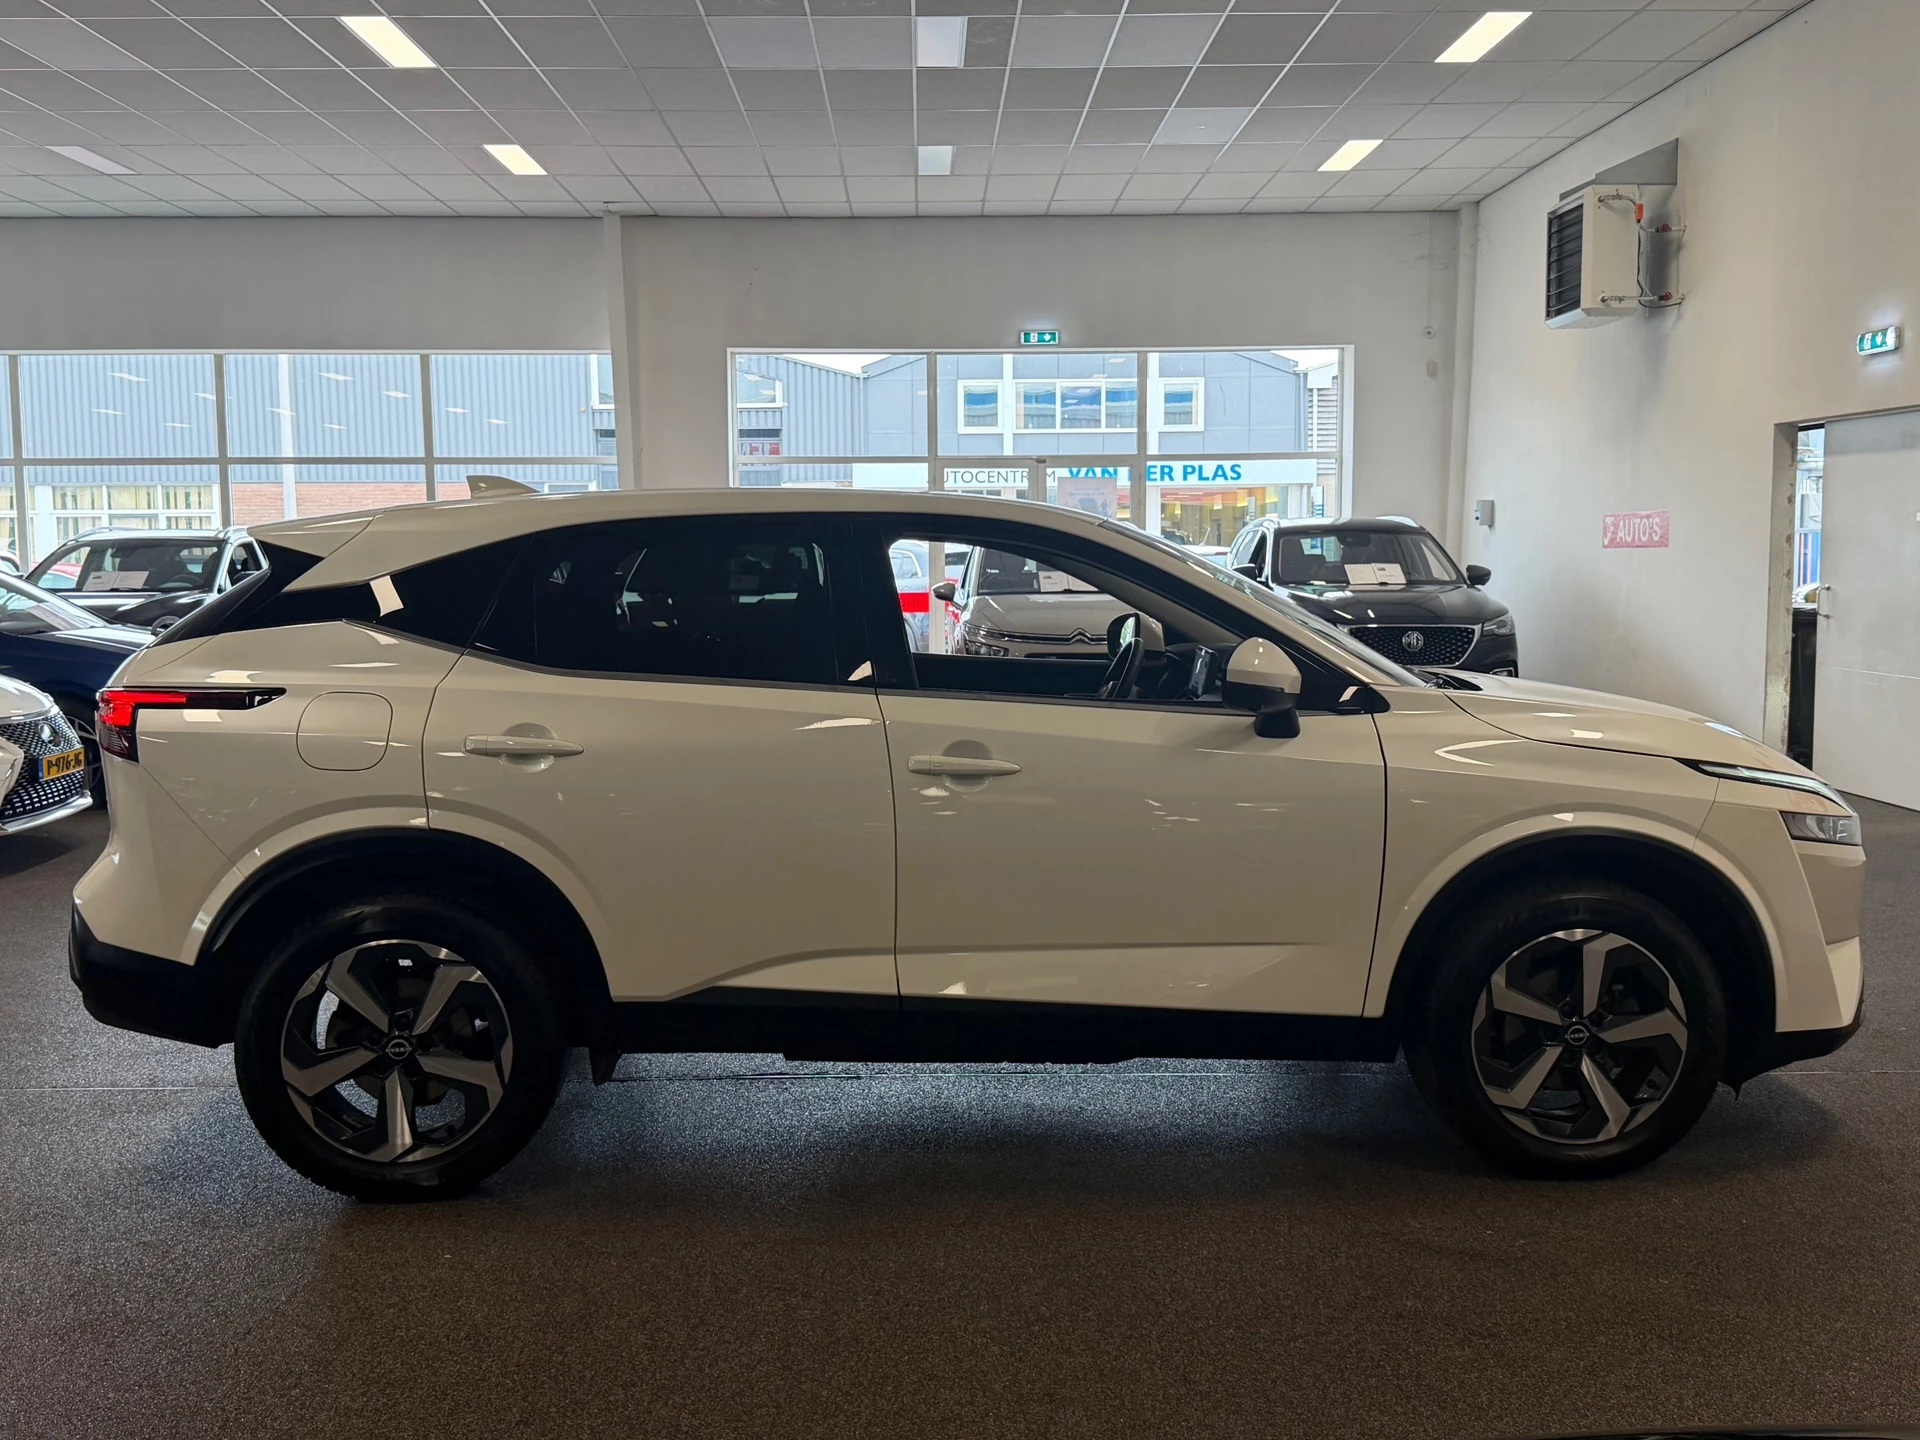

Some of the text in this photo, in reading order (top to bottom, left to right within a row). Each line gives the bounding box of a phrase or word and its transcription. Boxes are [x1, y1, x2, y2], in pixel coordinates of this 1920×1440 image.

[927, 464, 1242, 484] UTOCENTRM VAN ER PLAS
[1616, 517, 1661, 543] AUTO'S
